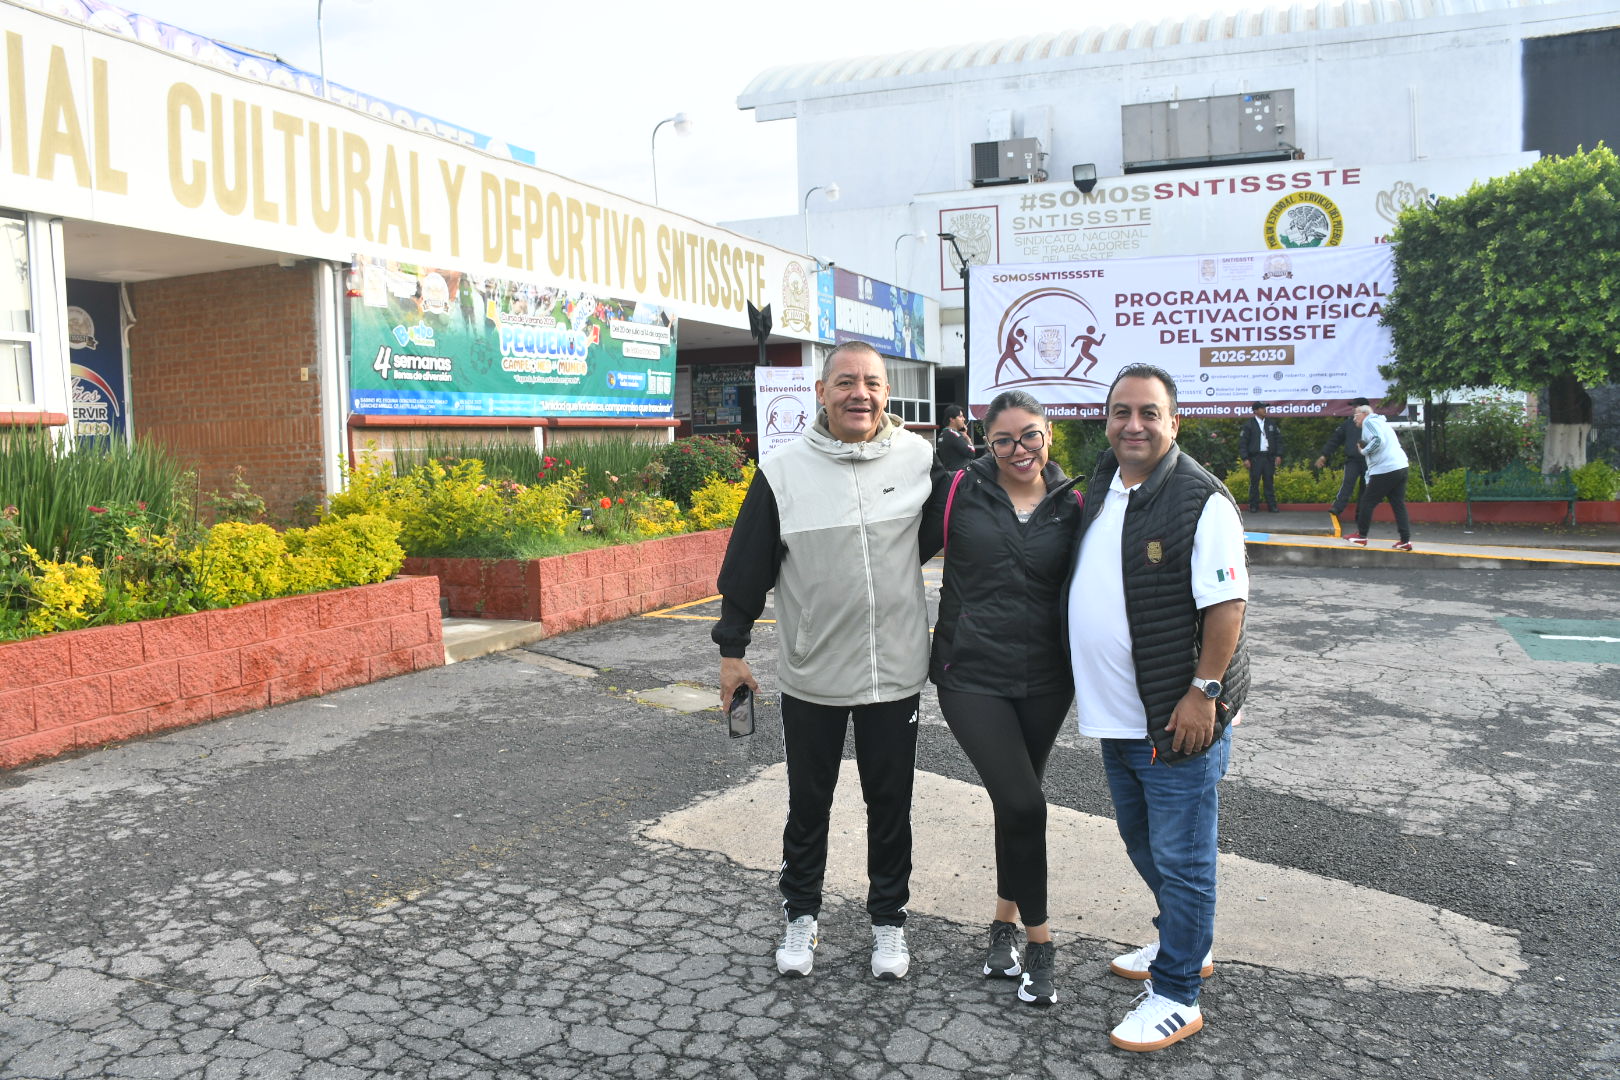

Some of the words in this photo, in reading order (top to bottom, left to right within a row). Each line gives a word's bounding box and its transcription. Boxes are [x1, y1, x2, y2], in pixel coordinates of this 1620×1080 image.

[0, 29, 128, 196] IAL
[166, 81, 431, 252] CULTURAL
[438, 158, 466, 258] Y
[481, 170, 646, 294] DEPORTIVO
[656, 223, 766, 312] SNTISSSTE
[1298, 193, 1333, 210] SERVICIO
[1013, 208, 1152, 230] SNTISSSTE
[1015, 234, 1077, 247] SINDICATO
[1083, 230, 1148, 241] NACIONAL
[1024, 247, 1039, 256] DE
[1045, 240, 1140, 254] TRABAJADORES
[1115, 288, 1250, 308] PROGRAMA
[1257, 281, 1386, 302] NACIONAL
[1115, 312, 1145, 327] DE
[1152, 303, 1298, 325] ACTIVACIÓN
[1305, 300, 1382, 320] FÍSICA
[1160, 329, 1204, 344] DEL
[1210, 324, 1336, 343] SNTISSSTE
[374, 346, 392, 379] 4
[393, 355, 452, 371] semanas
[1210, 349, 1287, 363] 2026-2030
[760, 385, 812, 393] Bienvenidos
[73, 408, 106, 418] ERVIR
[1080, 407, 1100, 417] que
[1177, 405, 1230, 417] mpromiso
[1265, 402, 1328, 415] rasciende"
